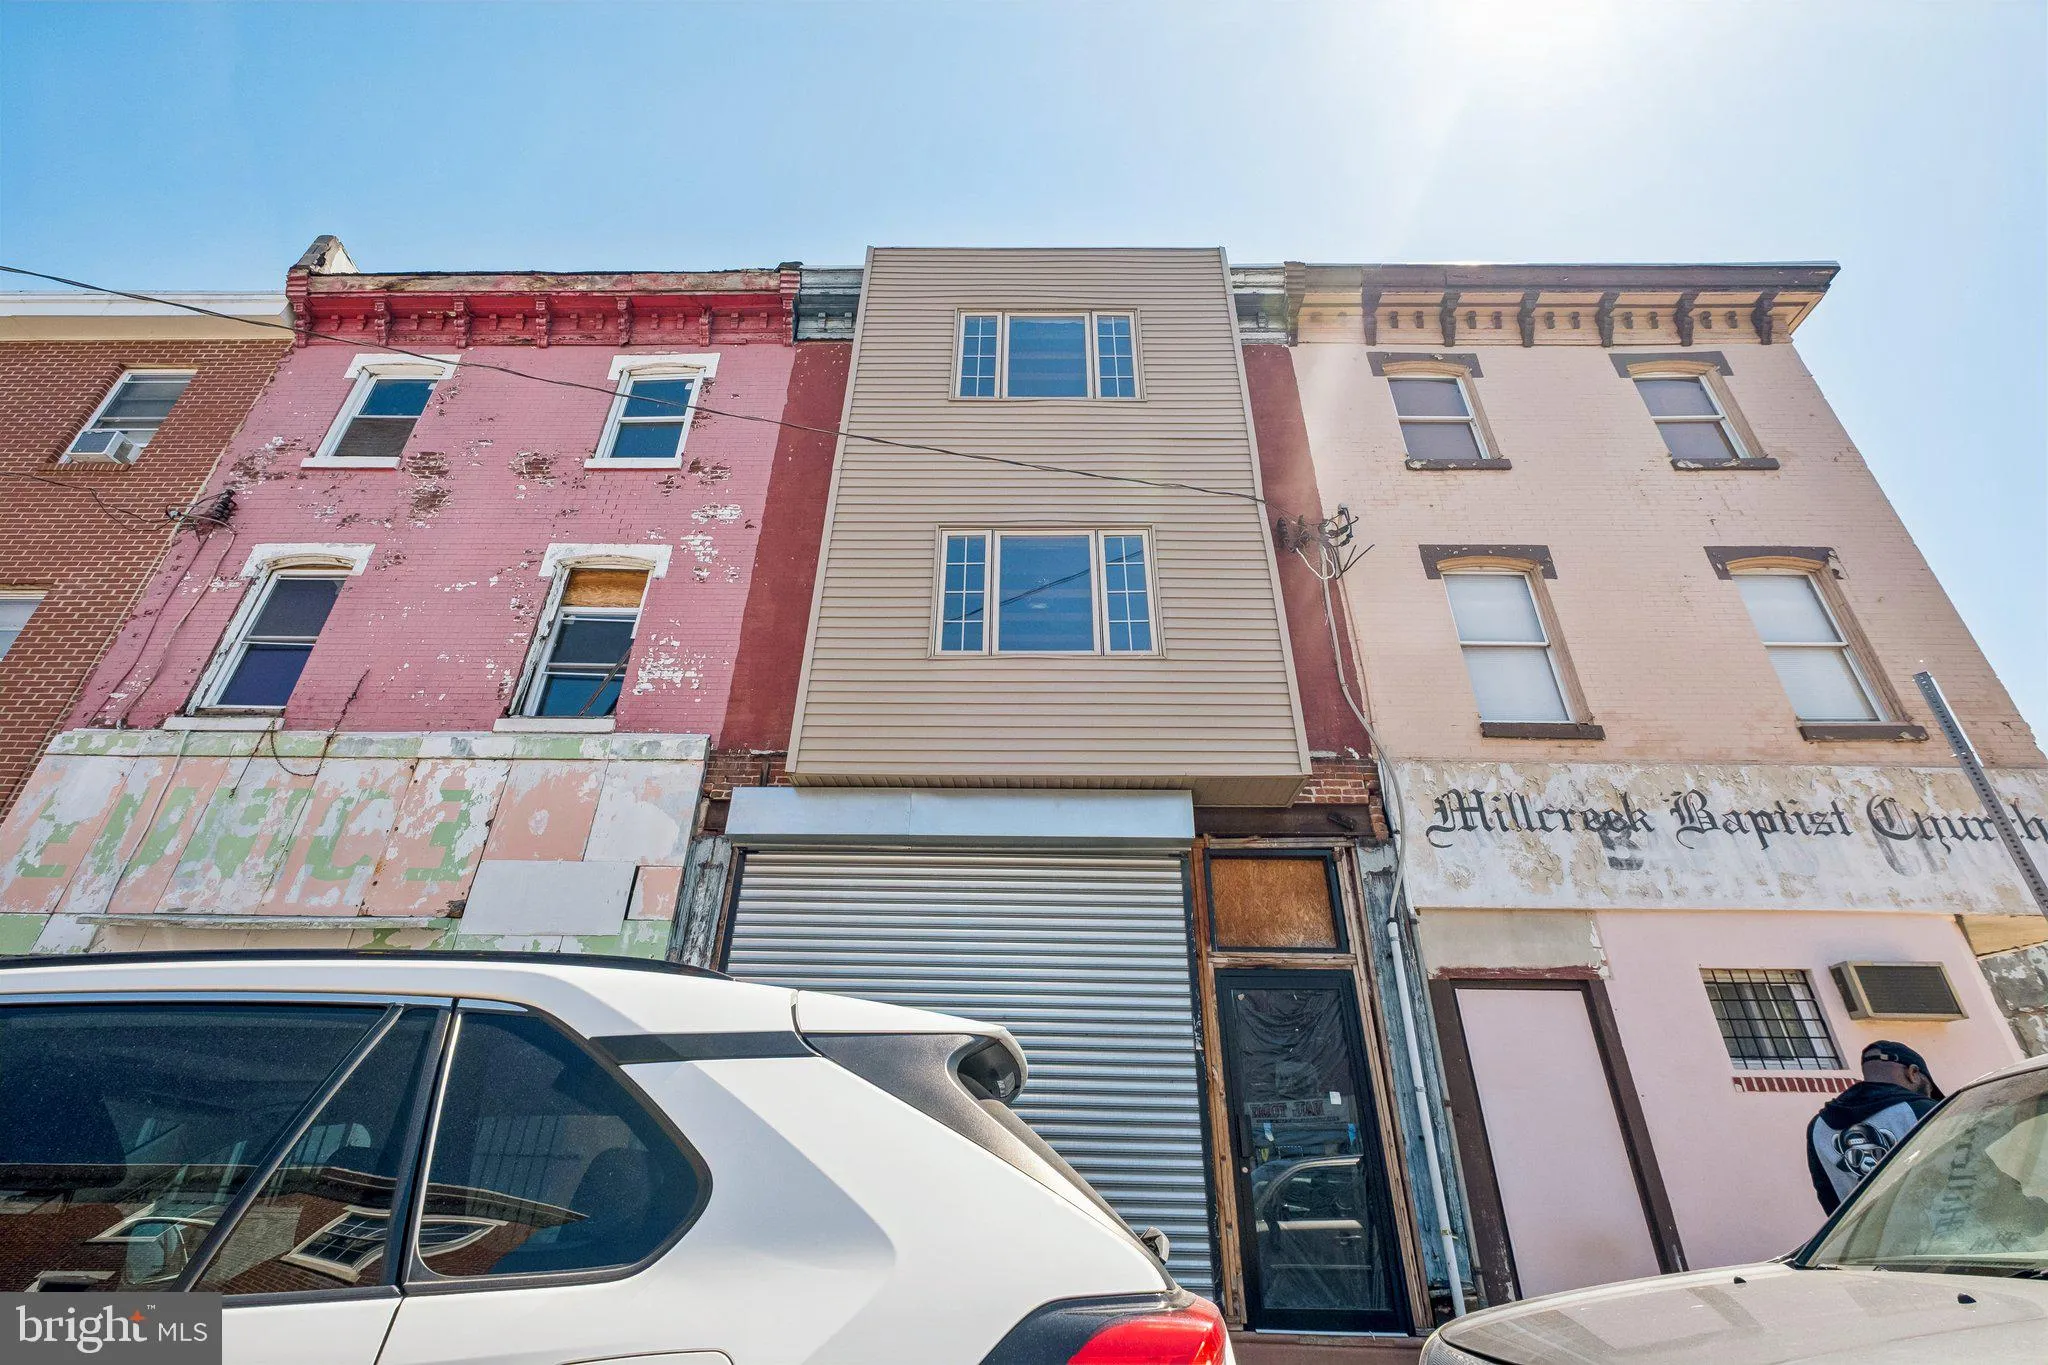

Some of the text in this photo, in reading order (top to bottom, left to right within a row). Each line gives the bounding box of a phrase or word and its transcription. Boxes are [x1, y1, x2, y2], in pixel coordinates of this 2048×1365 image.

[1425, 788, 2048, 854] Millcreek Baptist Churh
